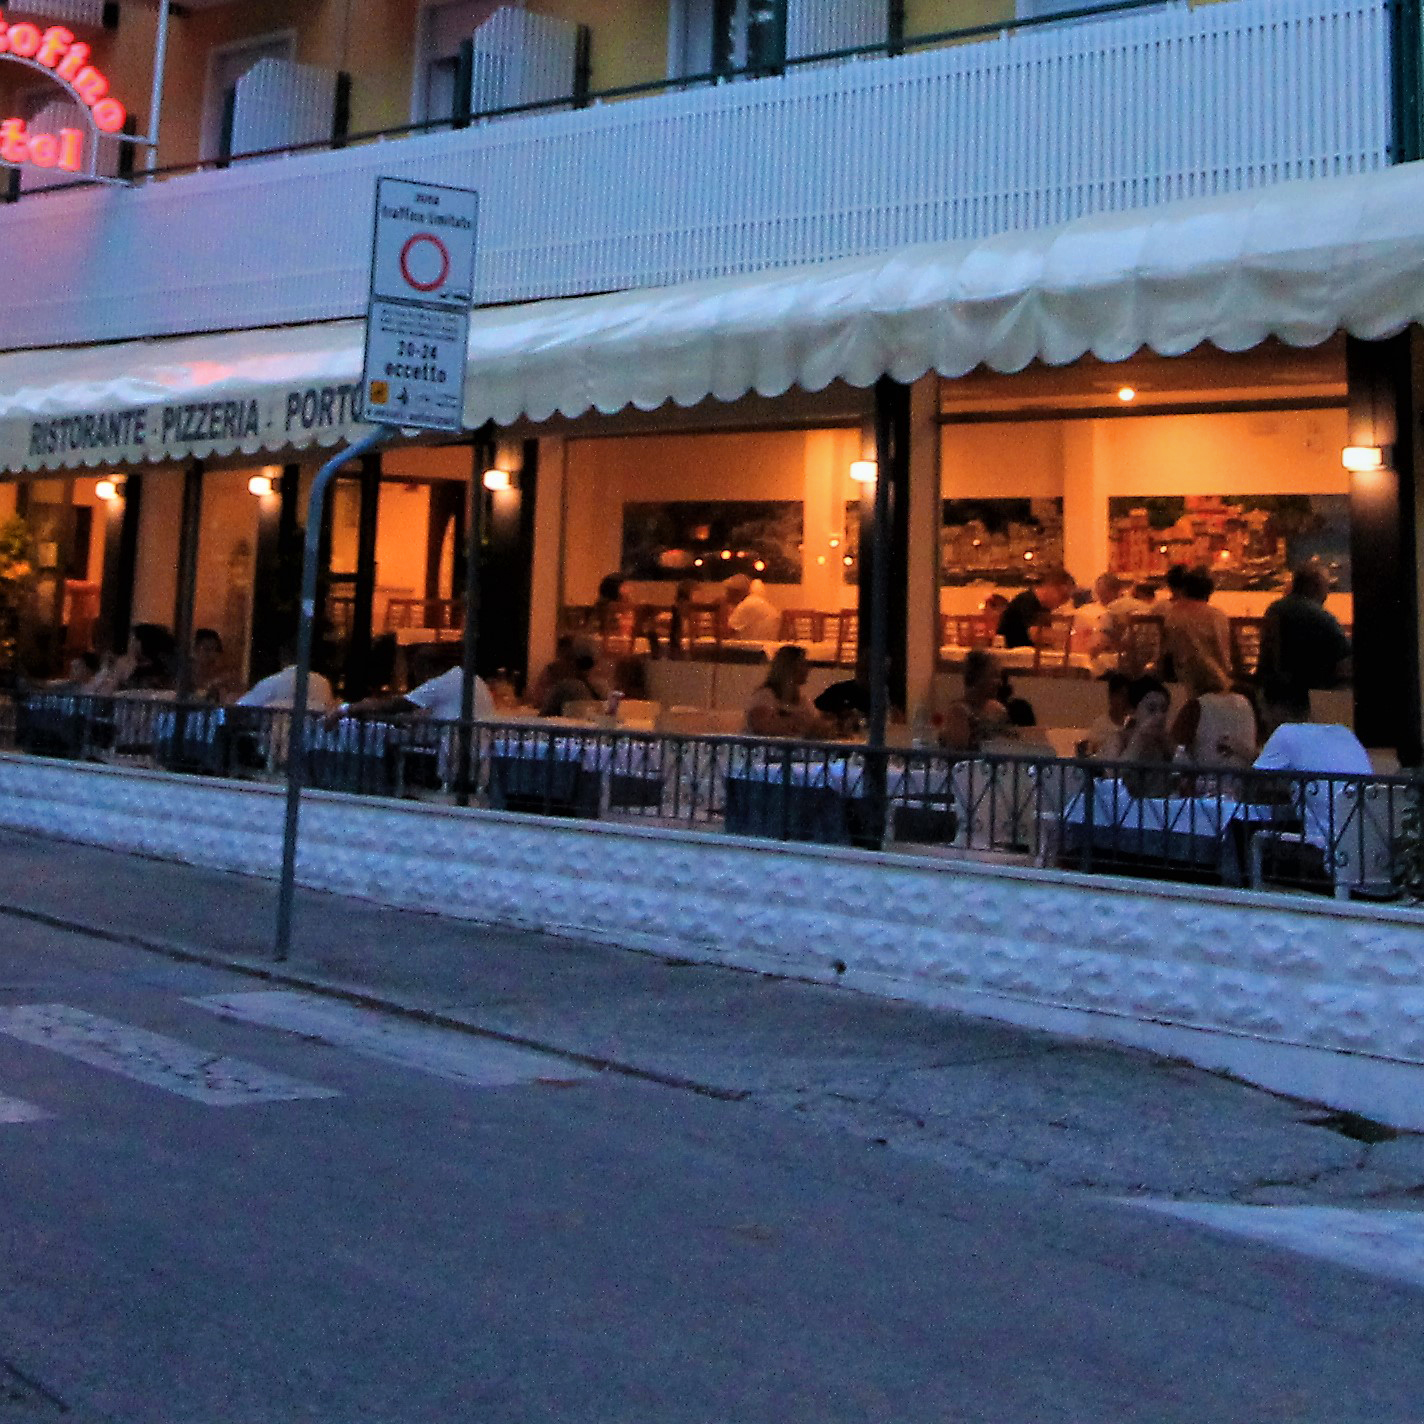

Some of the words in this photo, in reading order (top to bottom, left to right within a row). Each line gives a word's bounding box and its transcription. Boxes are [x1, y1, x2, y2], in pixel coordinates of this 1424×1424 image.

[384, 361, 447, 383] eccetto
[29, 408, 147, 457] RISTORANTE
[162, 399, 258, 445] PIZZERIA
